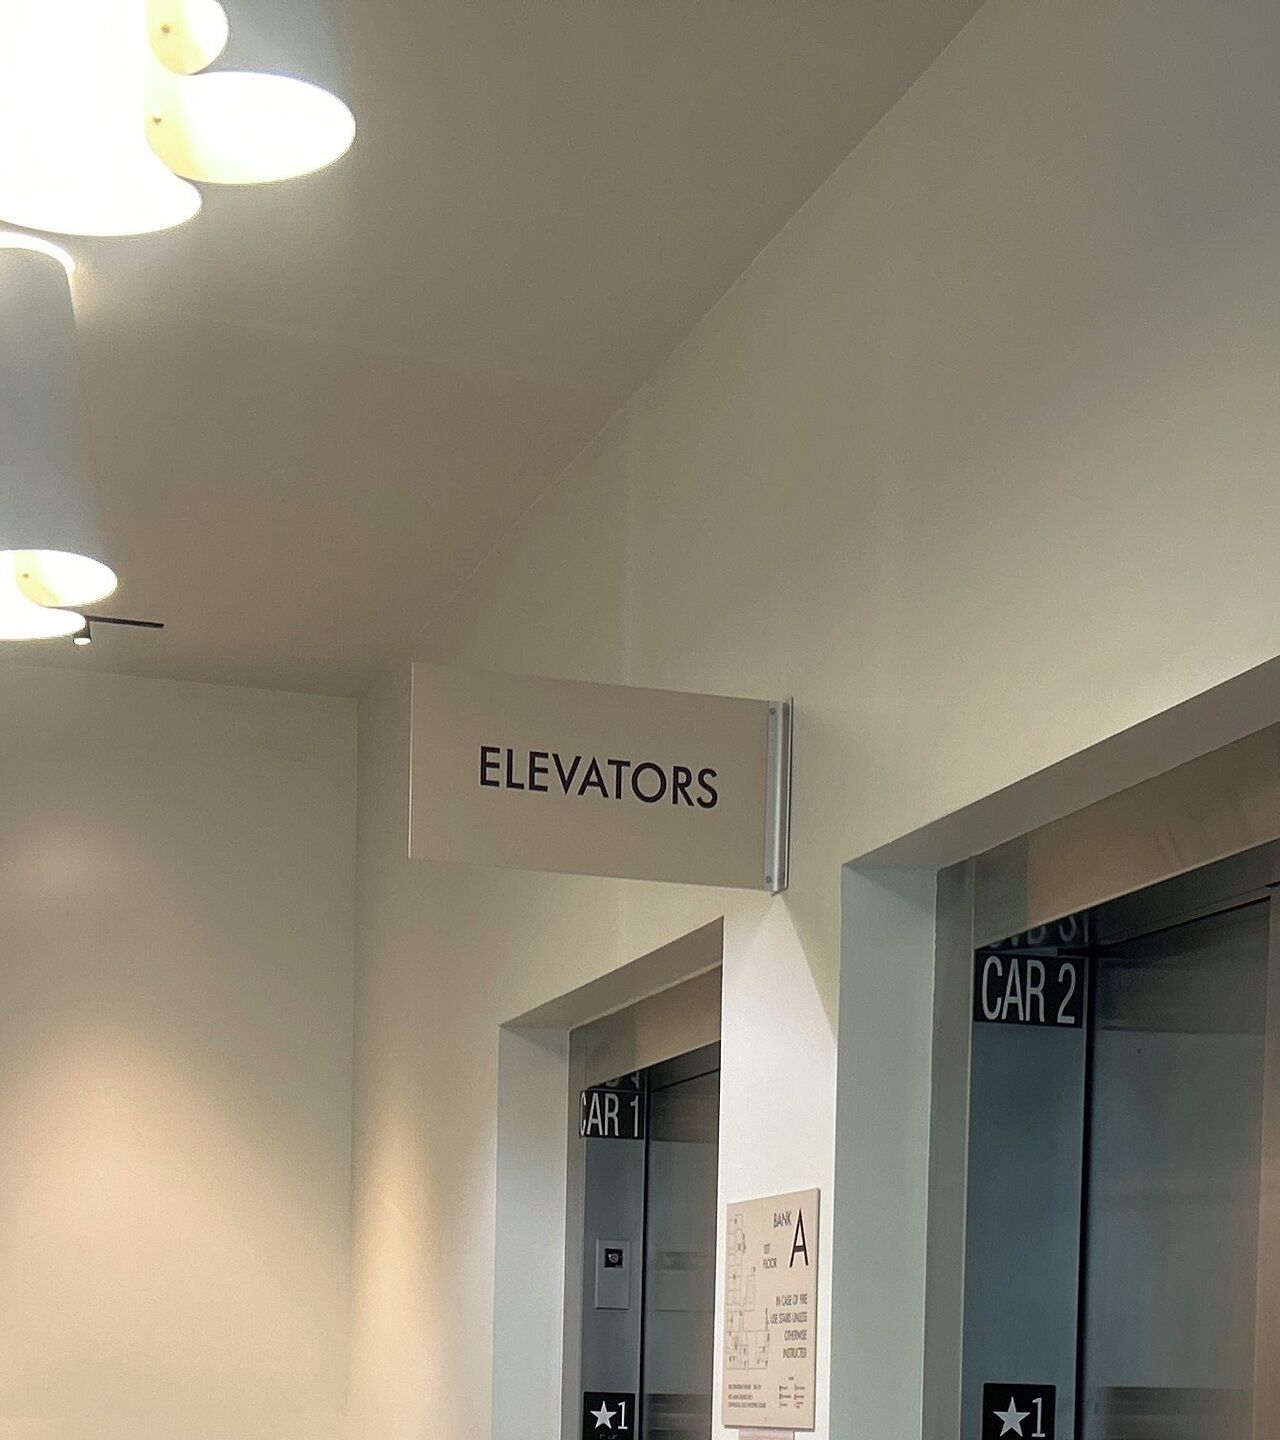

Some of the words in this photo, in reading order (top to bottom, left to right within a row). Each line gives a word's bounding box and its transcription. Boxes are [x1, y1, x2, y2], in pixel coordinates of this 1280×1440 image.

[479, 745, 719, 809] ELEVATORS
[981, 955, 1046, 1023] CAR
[1056, 962, 1077, 1025] 2
[580, 1091, 620, 1137] CAR
[630, 1094, 639, 1138] 1
[773, 1210, 792, 1228] BANK
[789, 1207, 809, 1268] A
[618, 1401, 628, 1430] 1
[1031, 1397, 1046, 1438] 1
